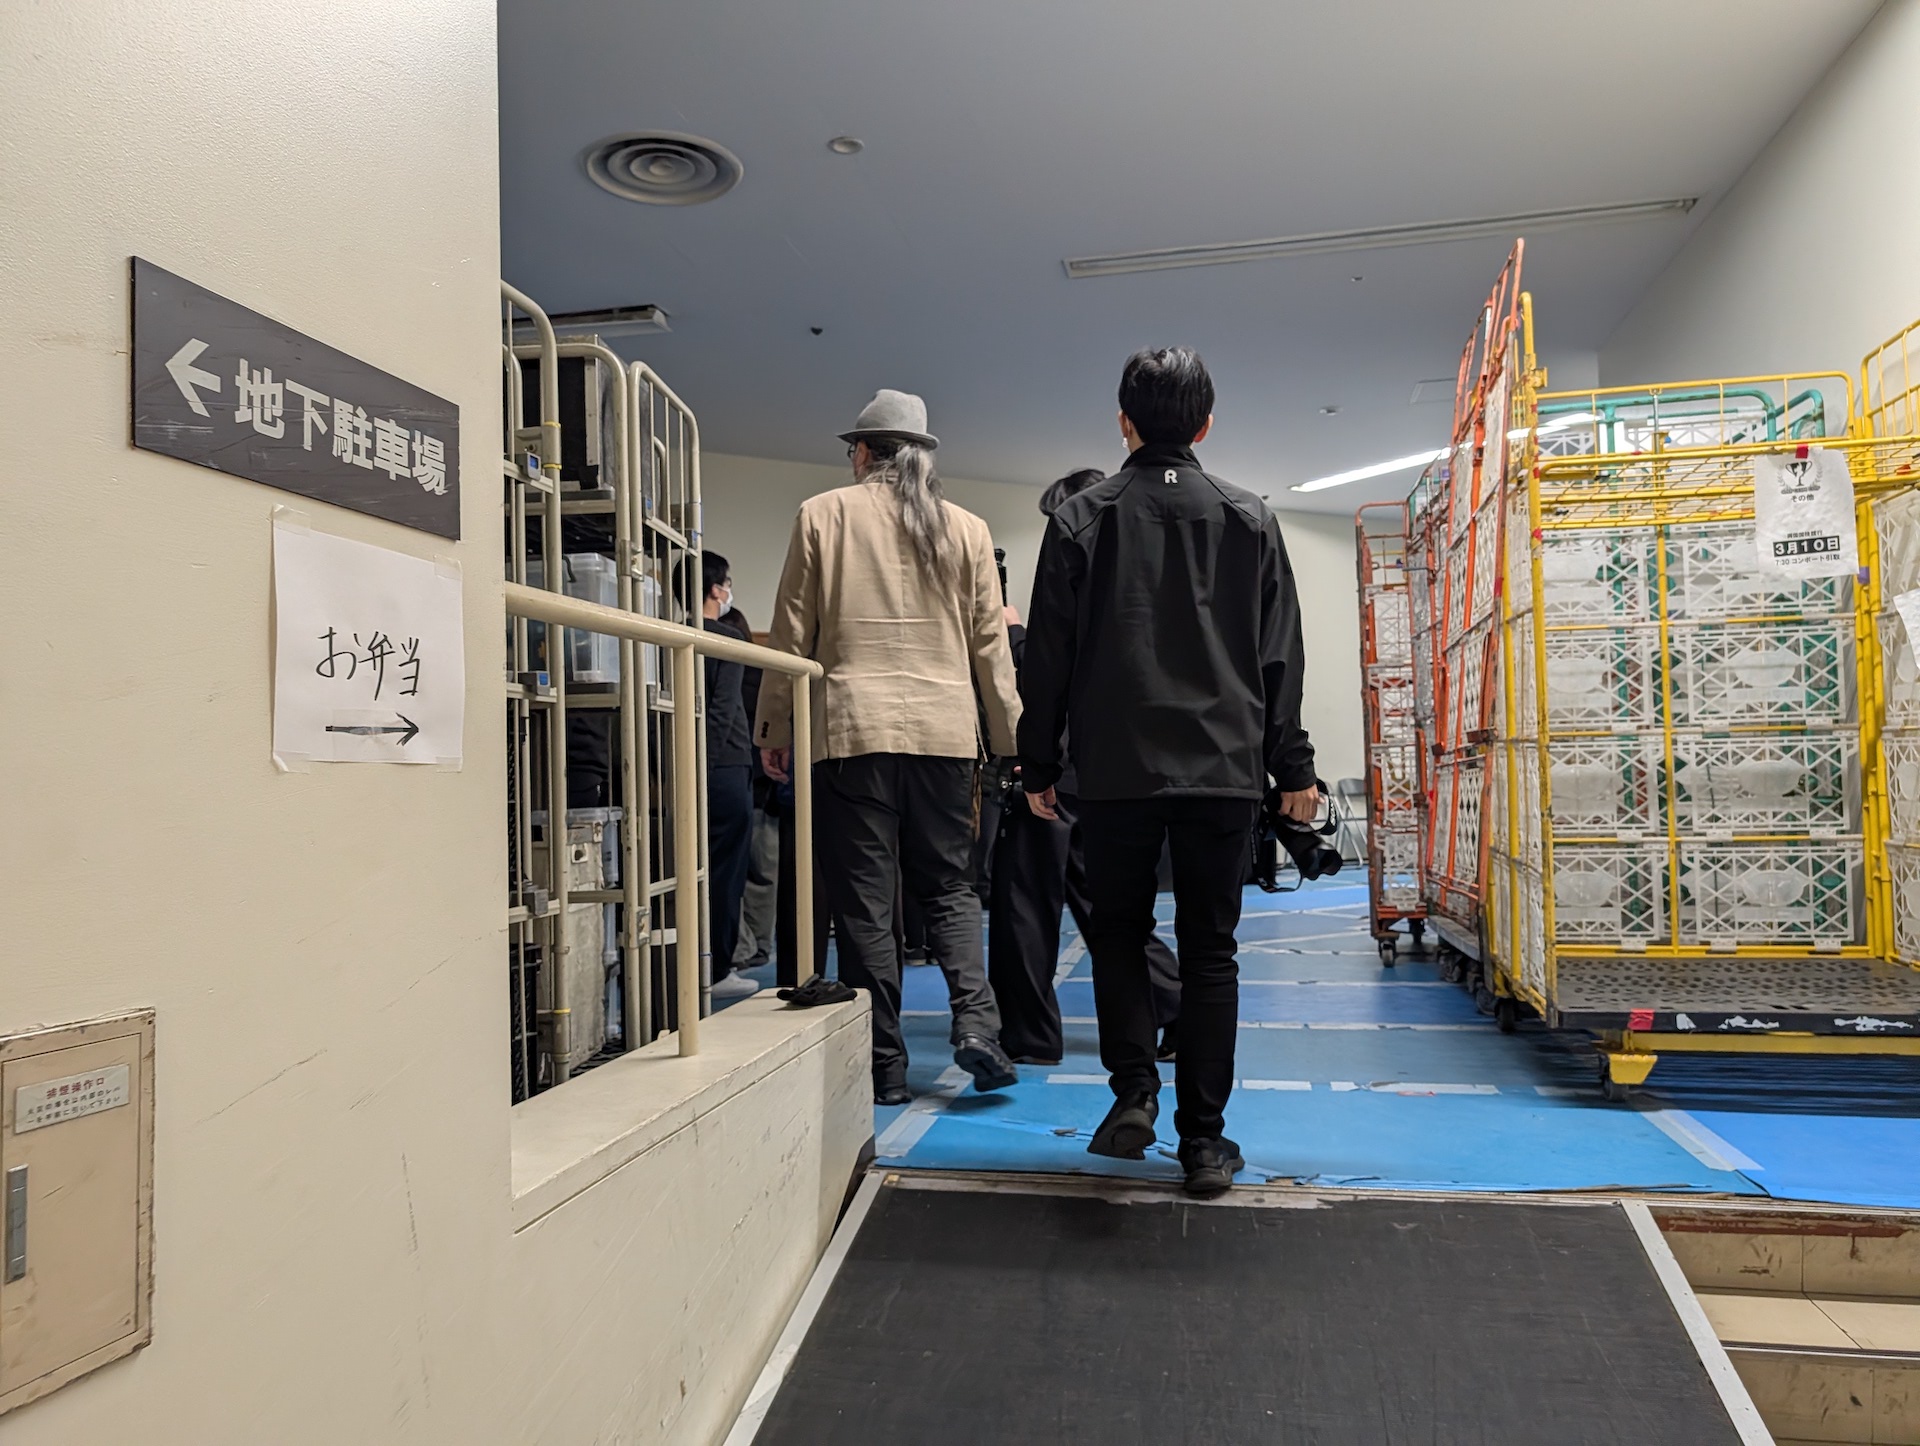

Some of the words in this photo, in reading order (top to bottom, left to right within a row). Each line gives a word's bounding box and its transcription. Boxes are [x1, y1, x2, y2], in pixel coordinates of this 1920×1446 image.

[234, 358, 449, 497] 地下駐車場
[1164, 469, 1178, 484] R
[1792, 493, 1815, 503] その他
[1775, 537, 1839, 555] 3月10日
[315, 626, 421, 701] お弁当
[46, 1077, 104, 1100] 排煙操作口
